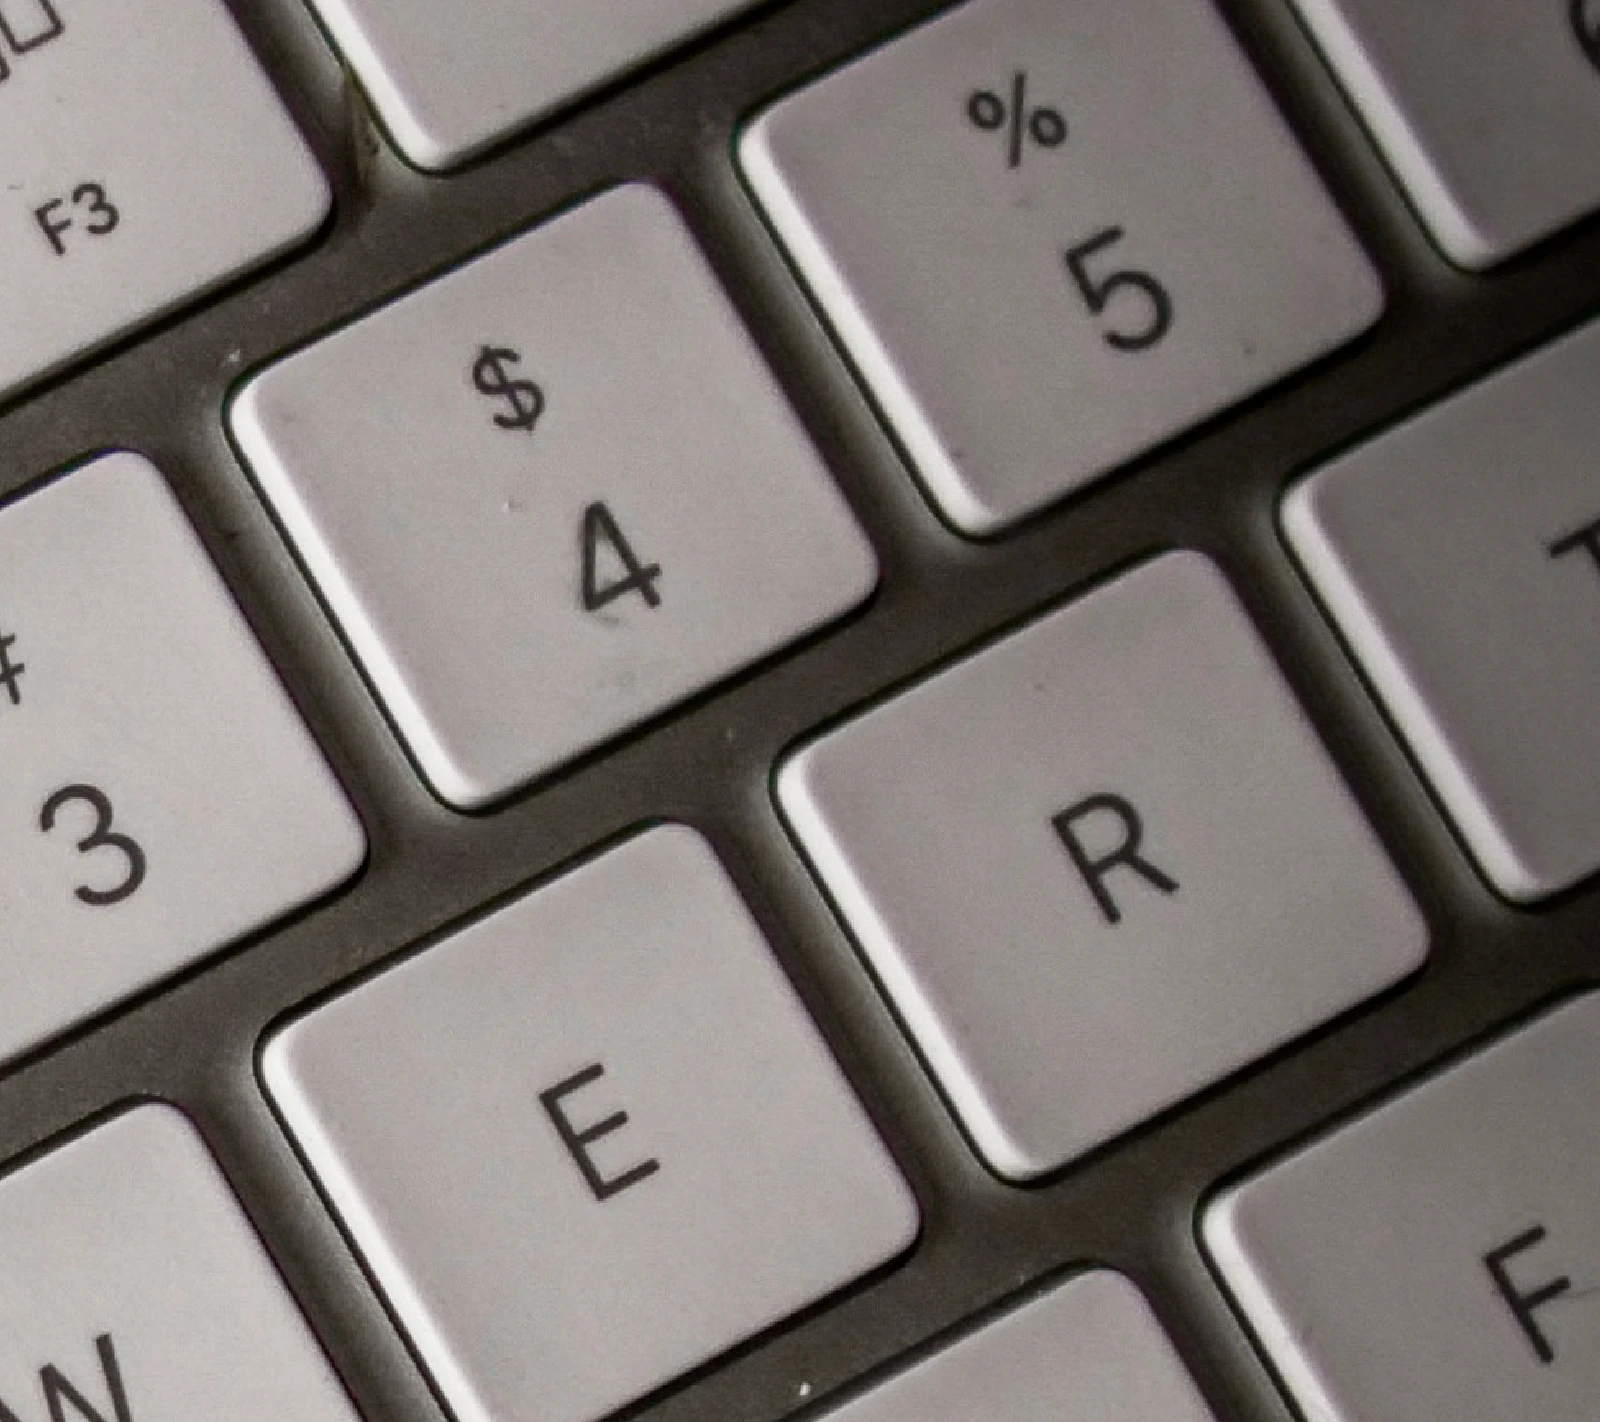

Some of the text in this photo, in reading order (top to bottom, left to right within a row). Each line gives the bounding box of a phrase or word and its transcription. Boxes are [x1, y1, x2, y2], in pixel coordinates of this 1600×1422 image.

[967, 72, 1068, 169] %
[33, 182, 119, 256] F3
[1064, 225, 1174, 353] 5
[472, 344, 545, 432] $
[578, 502, 662, 612] 4
[39, 784, 146, 906] 3
[1051, 792, 1180, 925] R
[537, 1063, 660, 1201] E
[1482, 1224, 1571, 1365] F
